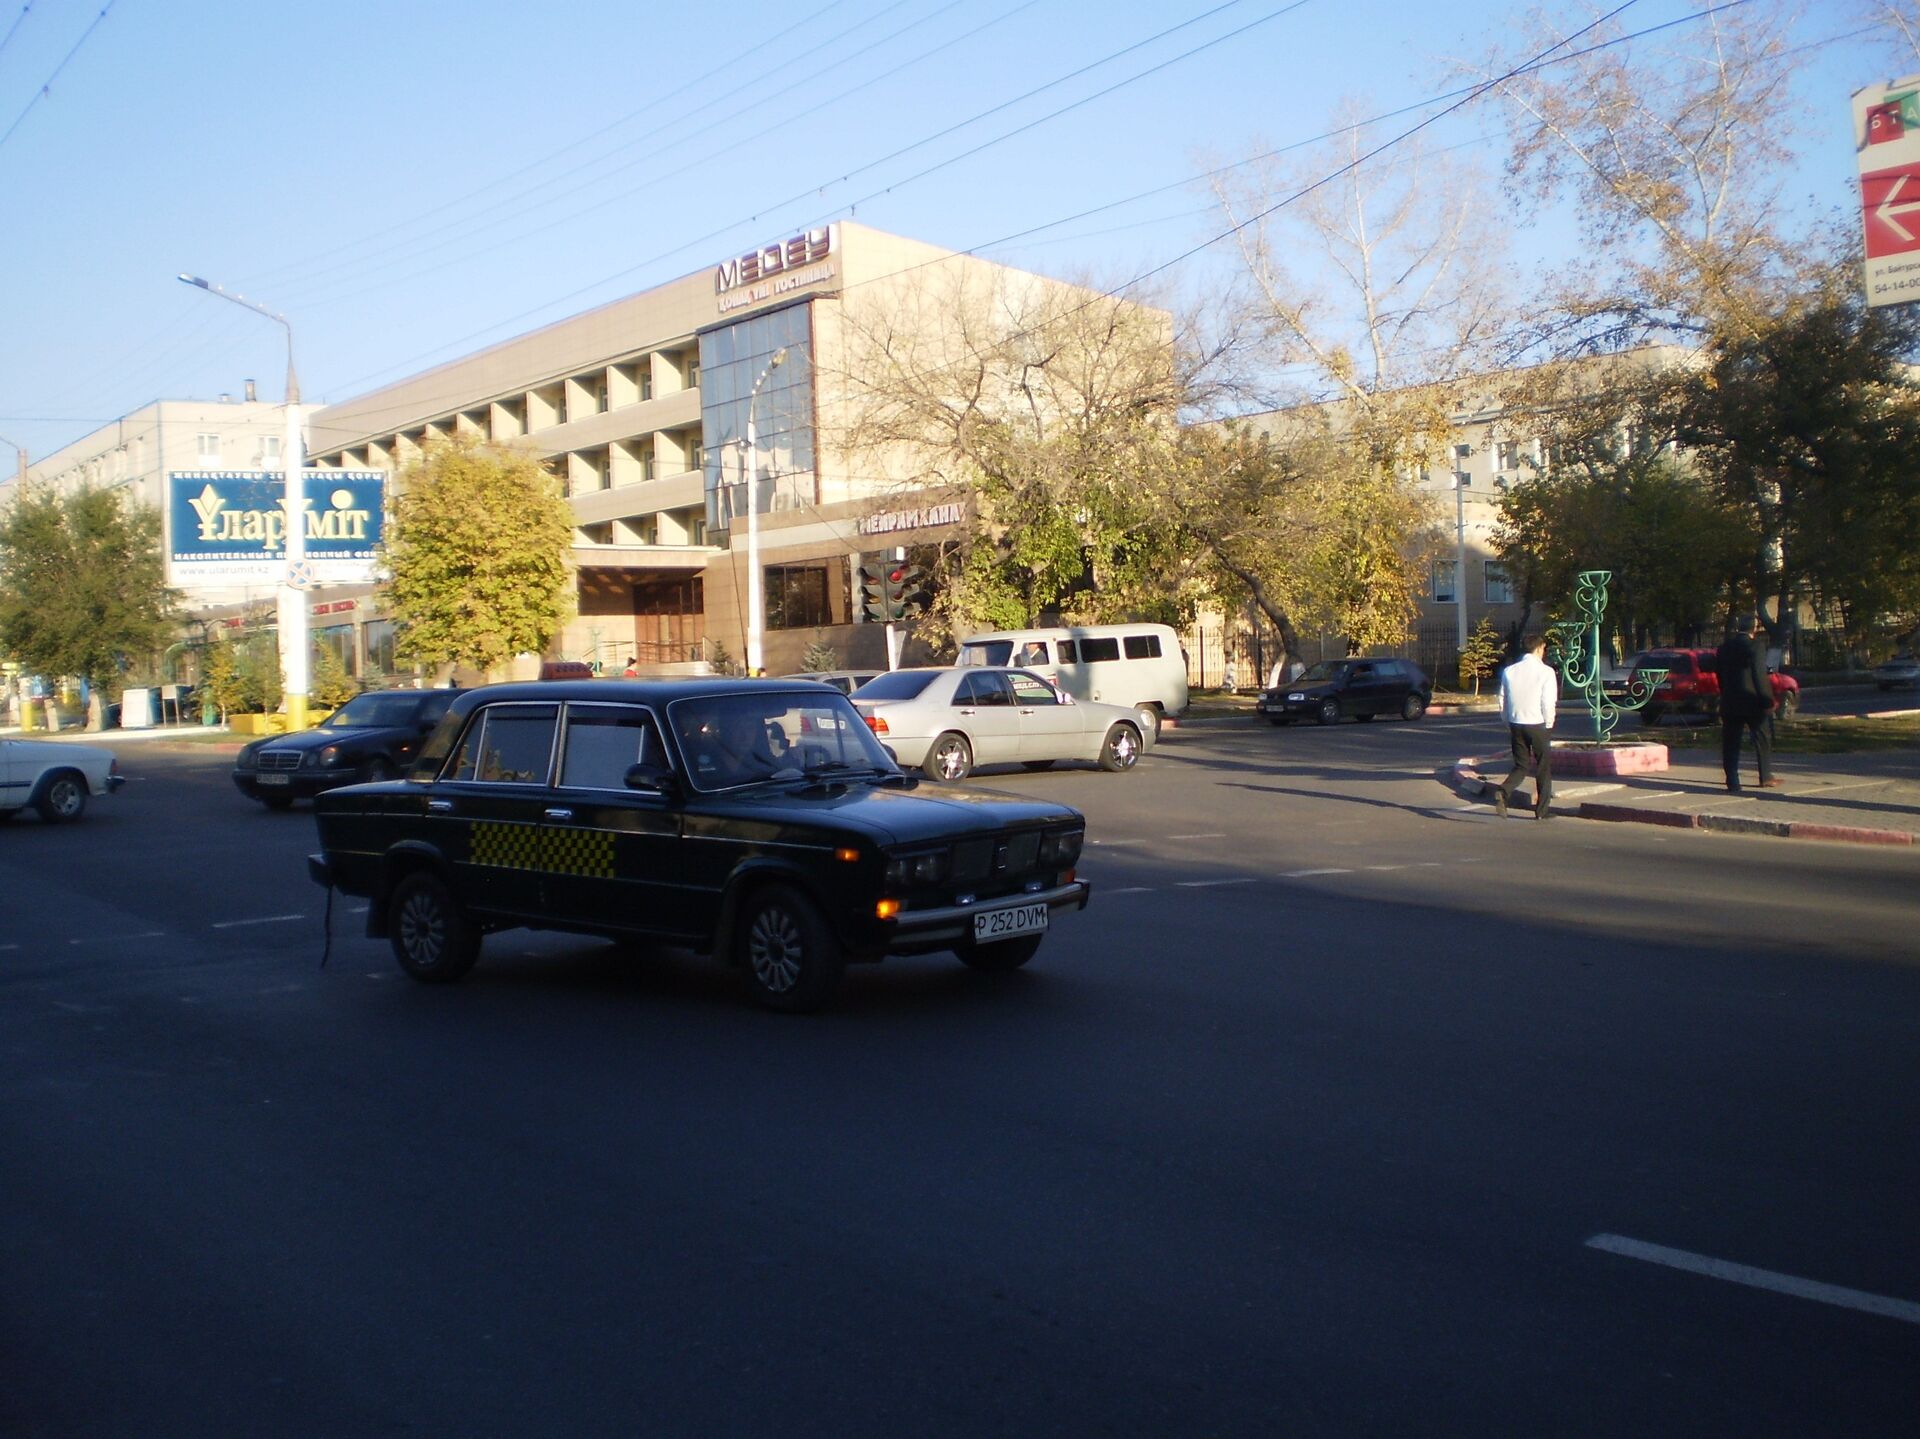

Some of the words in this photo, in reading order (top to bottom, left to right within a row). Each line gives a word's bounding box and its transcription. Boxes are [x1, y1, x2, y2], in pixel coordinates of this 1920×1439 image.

[715, 223, 836, 296] МЕДЕУ
[174, 551, 272, 561] НАКОПИТЕЛЬНЫЙ
[354, 550, 383, 559] ФОН
[977, 916, 987, 935] P
[990, 911, 1014, 933] 252
[1017, 905, 1046, 928] DVM
